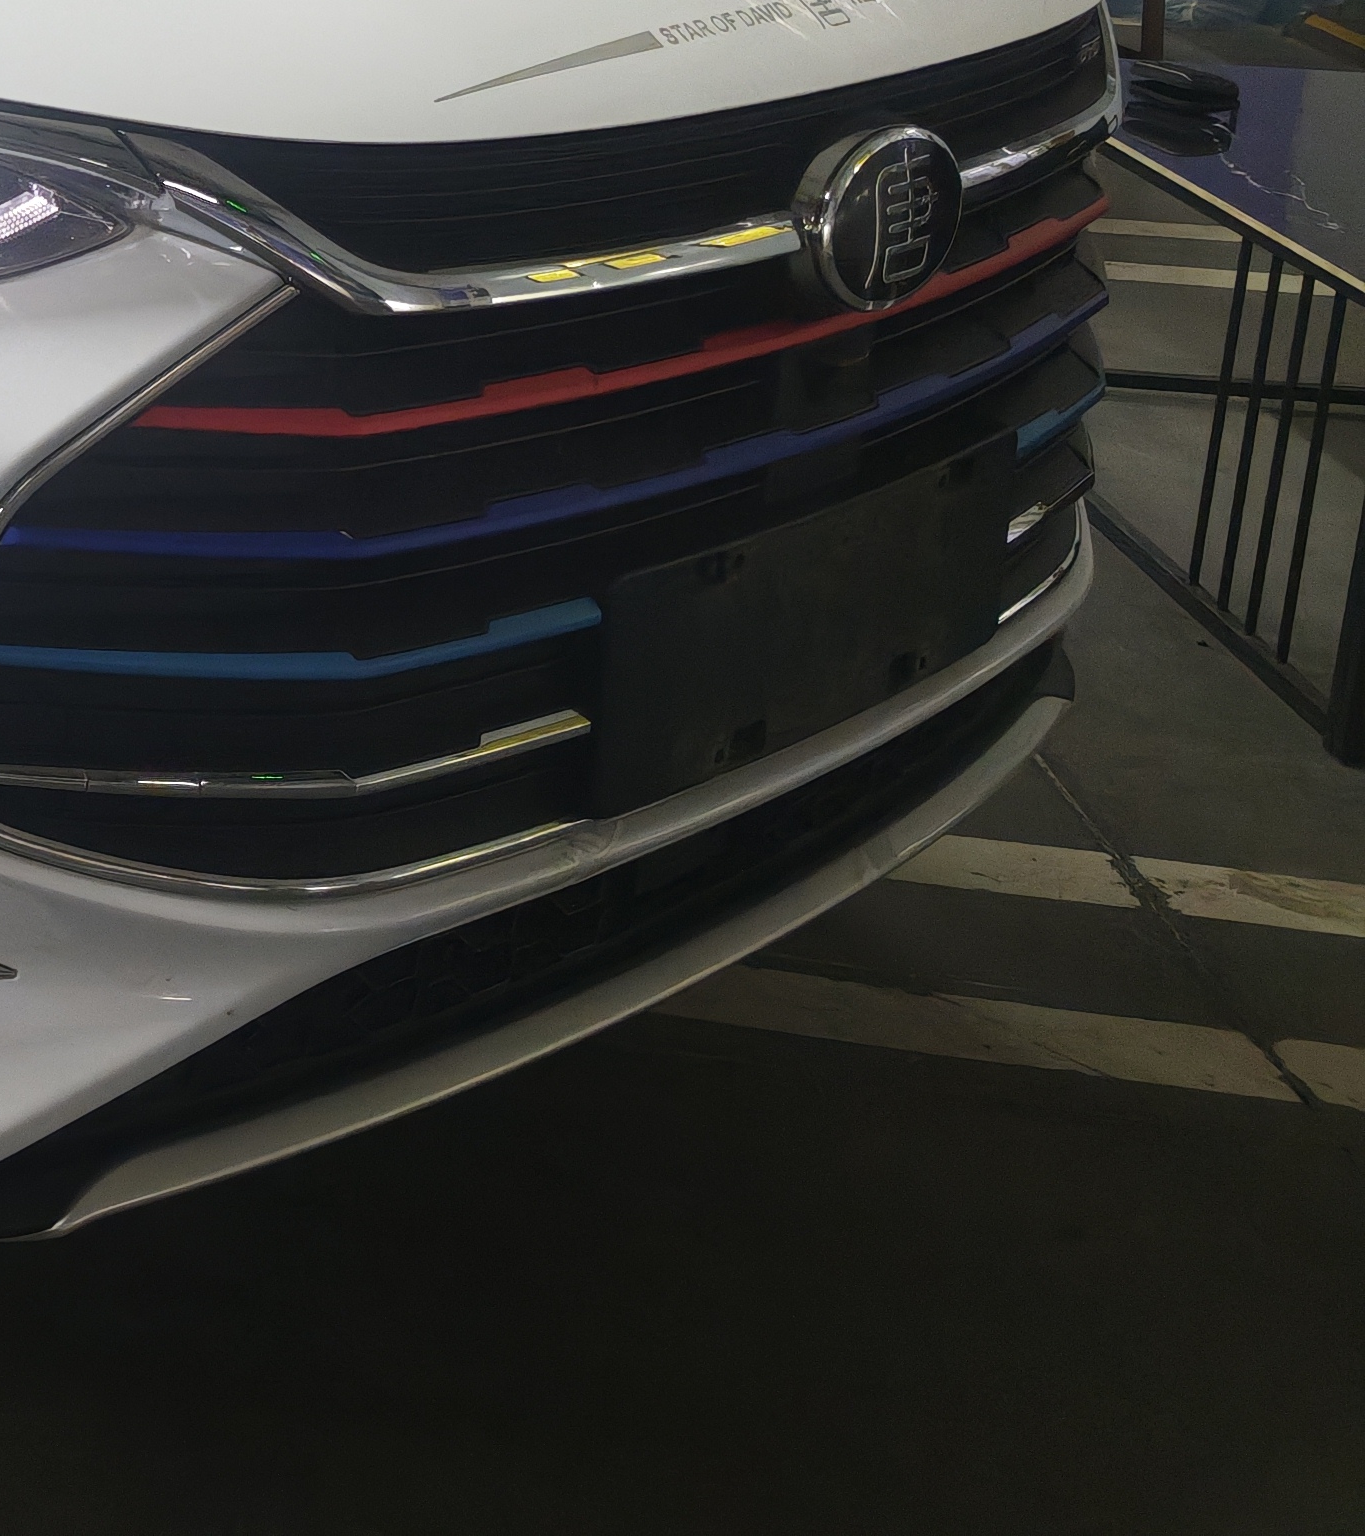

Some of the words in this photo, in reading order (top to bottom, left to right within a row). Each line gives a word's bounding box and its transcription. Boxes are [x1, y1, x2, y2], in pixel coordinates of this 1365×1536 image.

[659, 22, 717, 45] STAR
[718, 11, 740, 33] OF
[736, 1, 793, 28] DAVID
